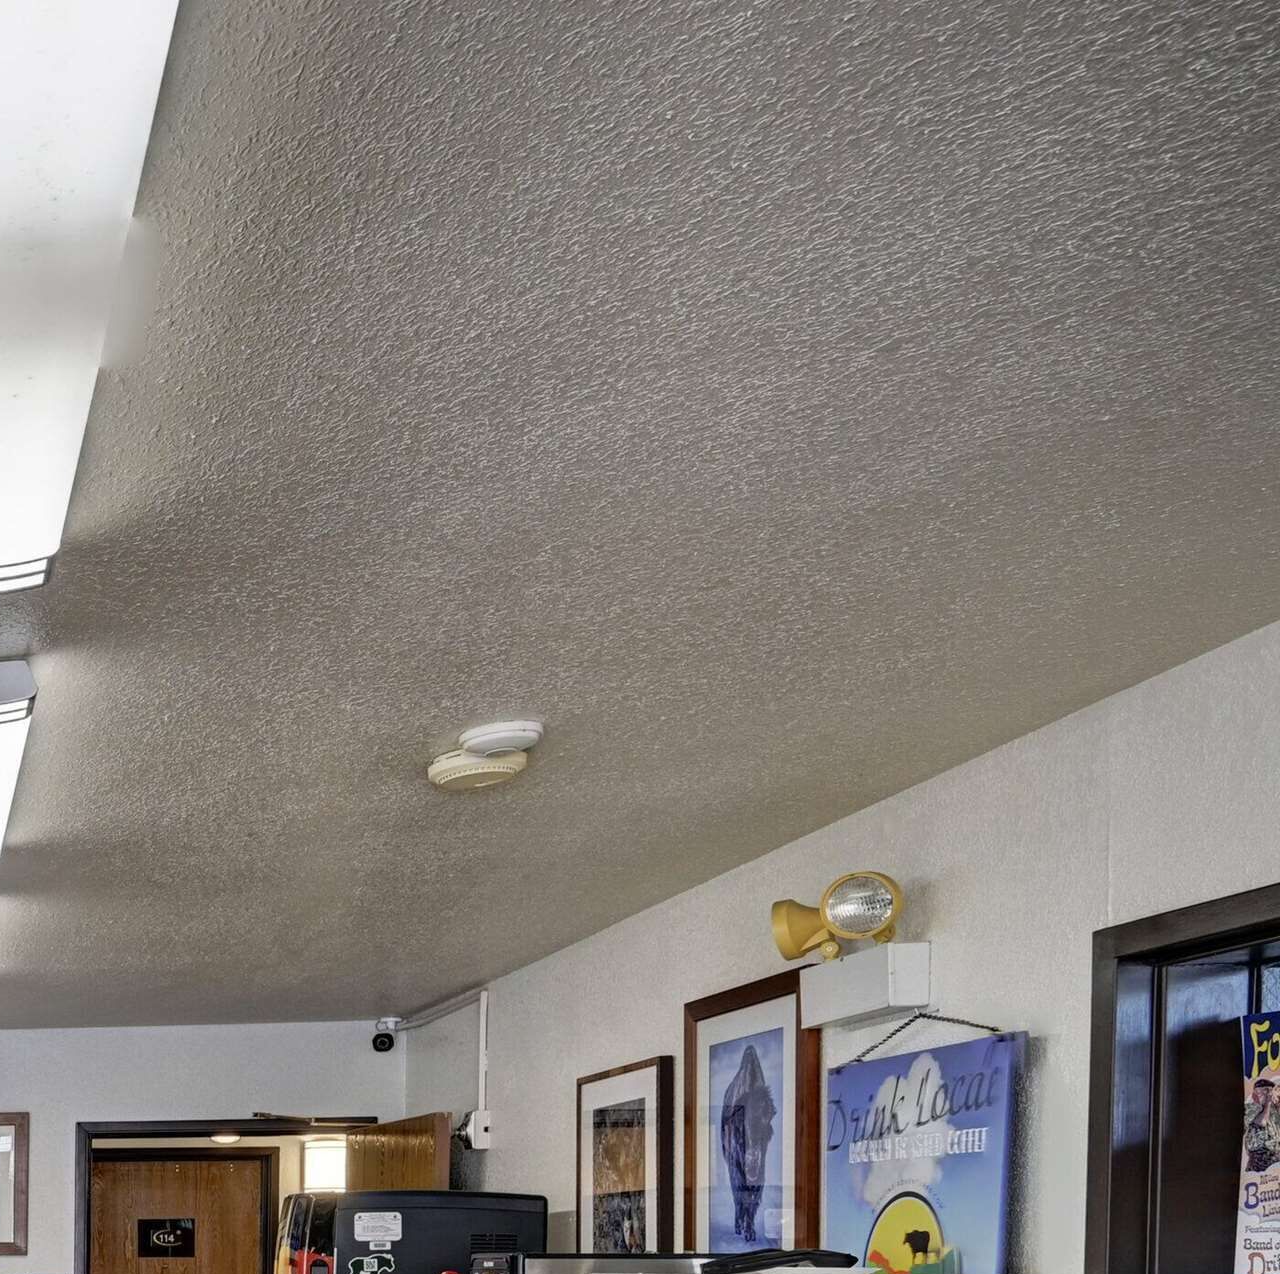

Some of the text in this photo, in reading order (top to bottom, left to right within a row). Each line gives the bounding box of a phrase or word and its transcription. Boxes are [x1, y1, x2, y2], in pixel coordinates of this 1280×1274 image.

[827, 1067, 999, 1151] Drink Local
[159, 1233, 175, 1243] 114
[1244, 1238, 1273, 1250] Band
